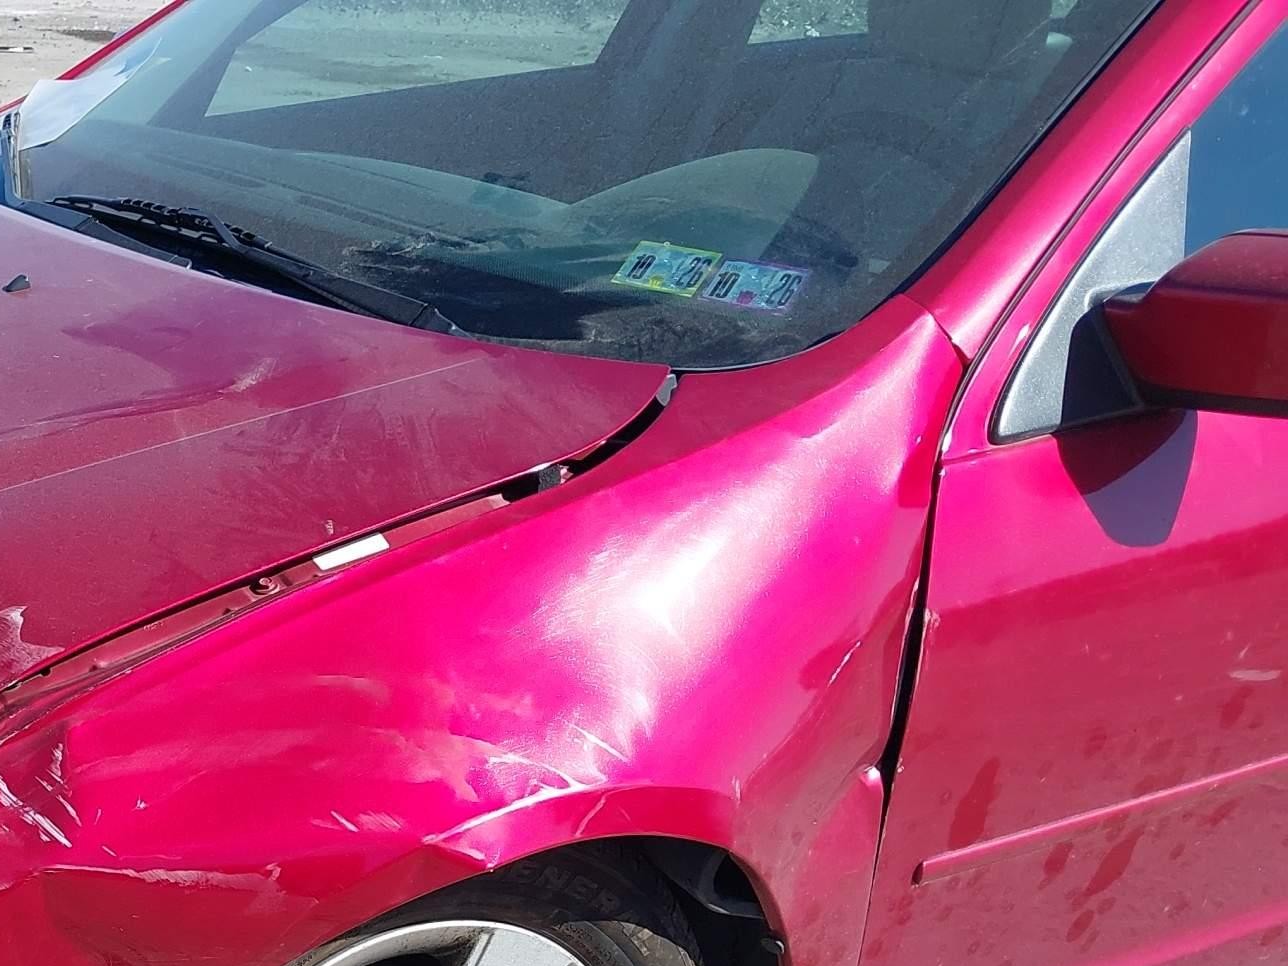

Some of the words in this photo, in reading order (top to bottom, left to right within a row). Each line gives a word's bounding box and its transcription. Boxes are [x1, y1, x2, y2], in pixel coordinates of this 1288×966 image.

[626, 254, 657, 280] 10
[675, 257, 712, 288] 26
[710, 271, 741, 299] 10
[765, 273, 802, 306] 26
